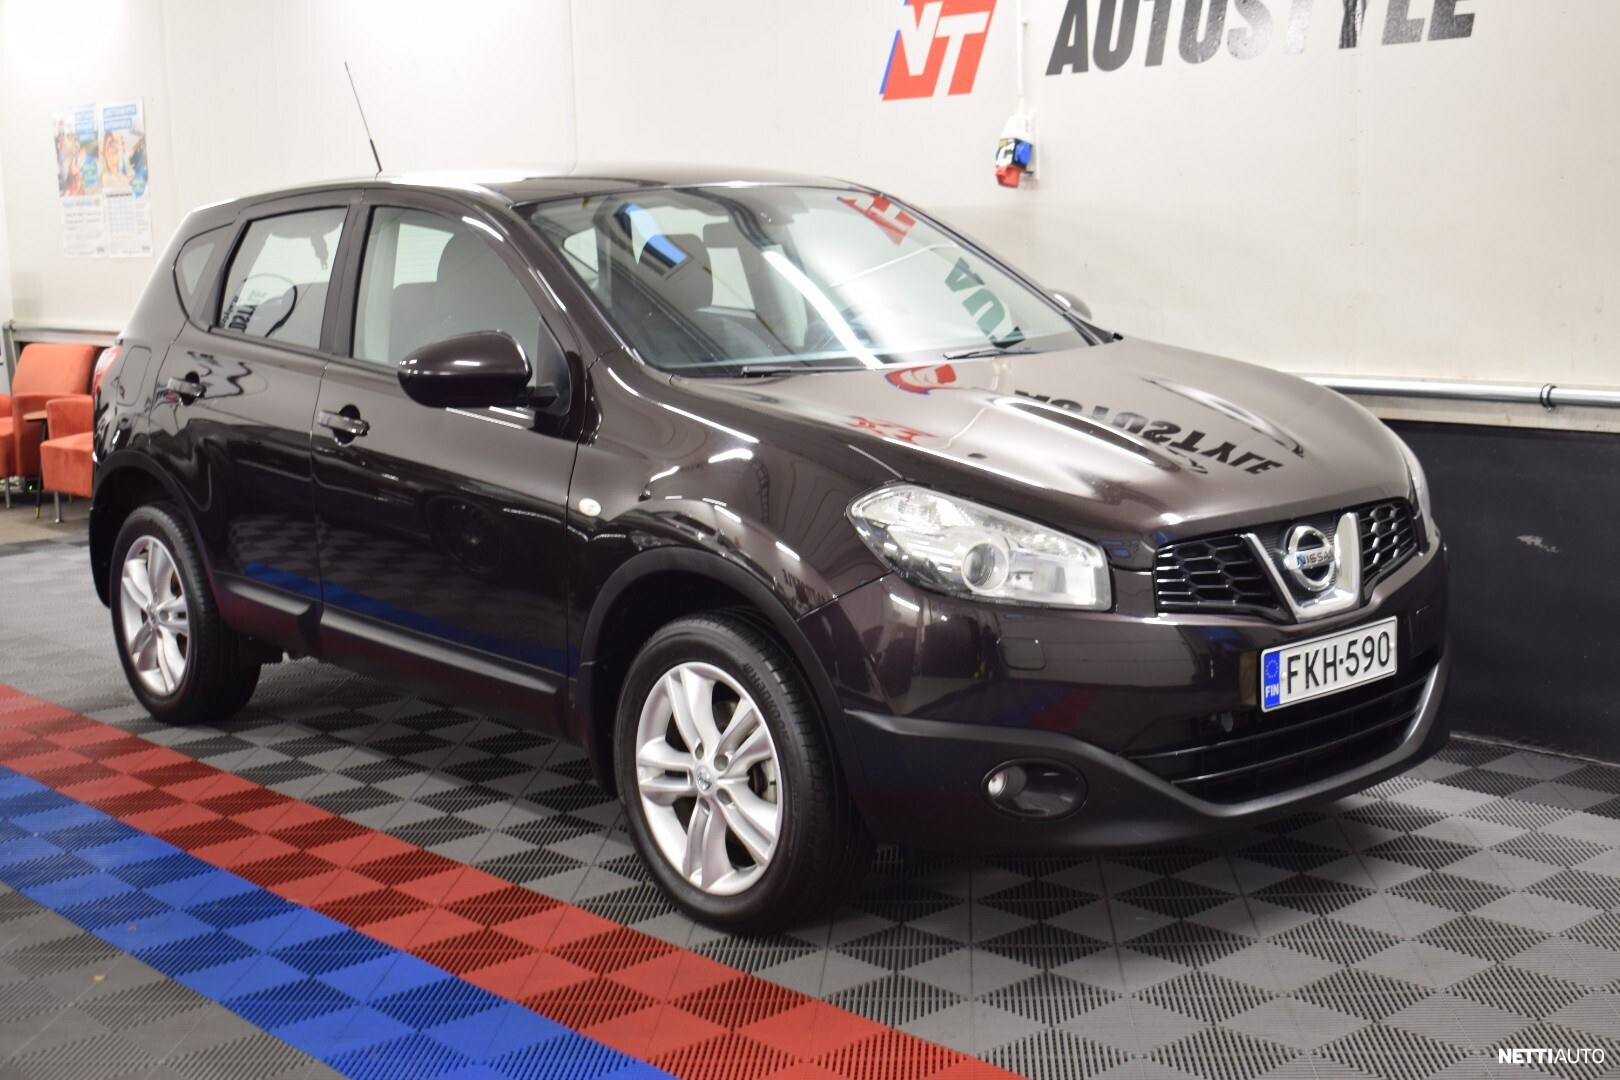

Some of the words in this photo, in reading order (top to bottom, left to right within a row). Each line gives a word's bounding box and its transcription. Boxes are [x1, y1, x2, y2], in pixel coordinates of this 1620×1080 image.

[880, 0, 992, 101] NT
[1265, 683, 1279, 699] FIN
[1287, 631, 1390, 694] FKH-590
